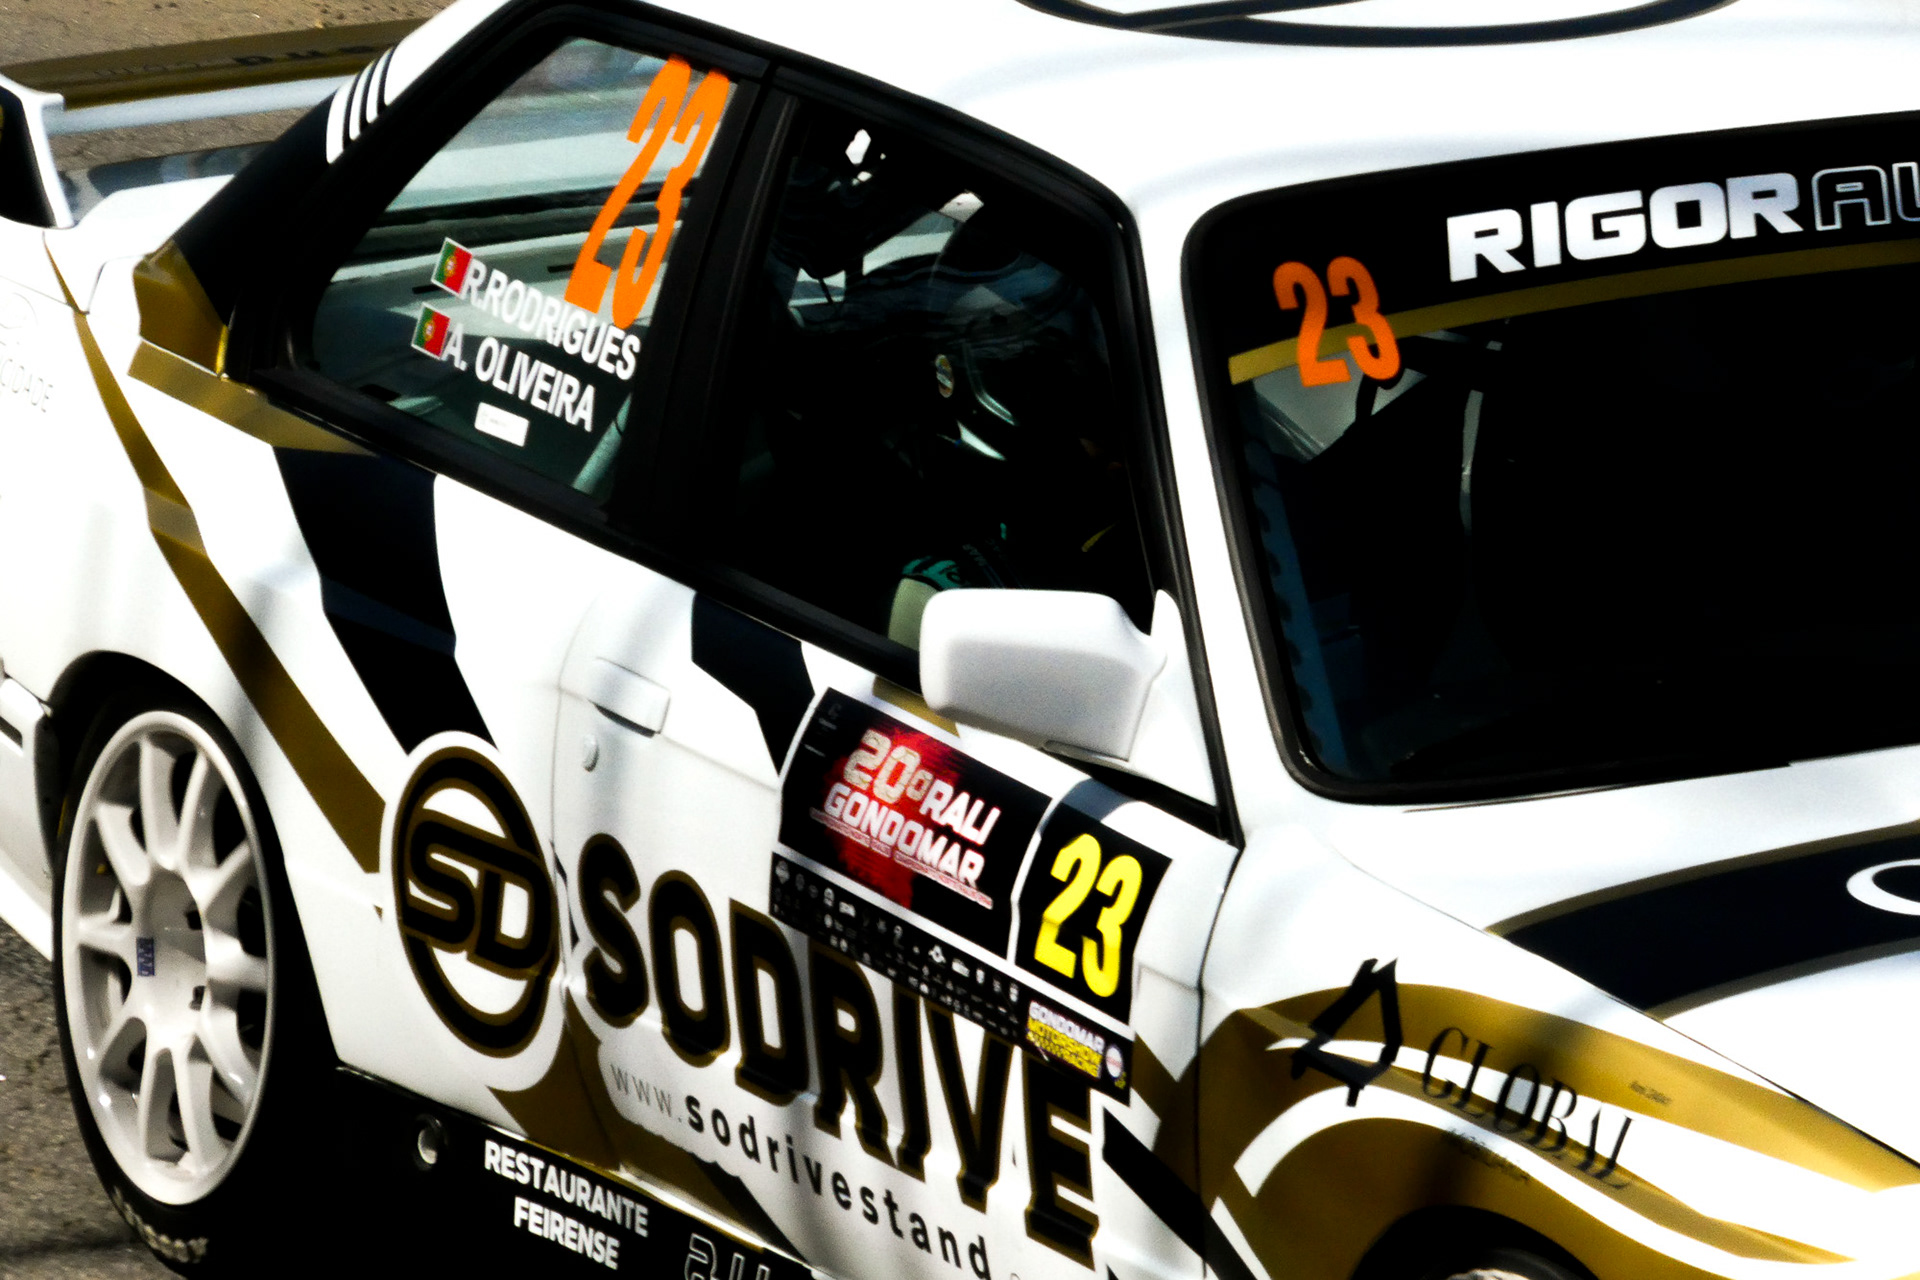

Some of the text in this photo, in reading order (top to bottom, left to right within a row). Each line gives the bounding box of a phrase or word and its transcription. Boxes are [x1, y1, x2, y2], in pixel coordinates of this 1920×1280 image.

[564, 53, 730, 329] 23
[460, 260, 641, 381] R.RODRIGUES
[1273, 256, 1400, 387] 23
[441, 324, 596, 432] A. OLIVEIRA
[824, 782, 985, 889] GONDOMAR
[919, 779, 1001, 846] RALI
[1034, 833, 1143, 998] 23
[578, 832, 1100, 1271] SODRIVE
[484, 1139, 649, 1238] RESTAURANTE
[513, 1196, 620, 1270] FEIRENSE
